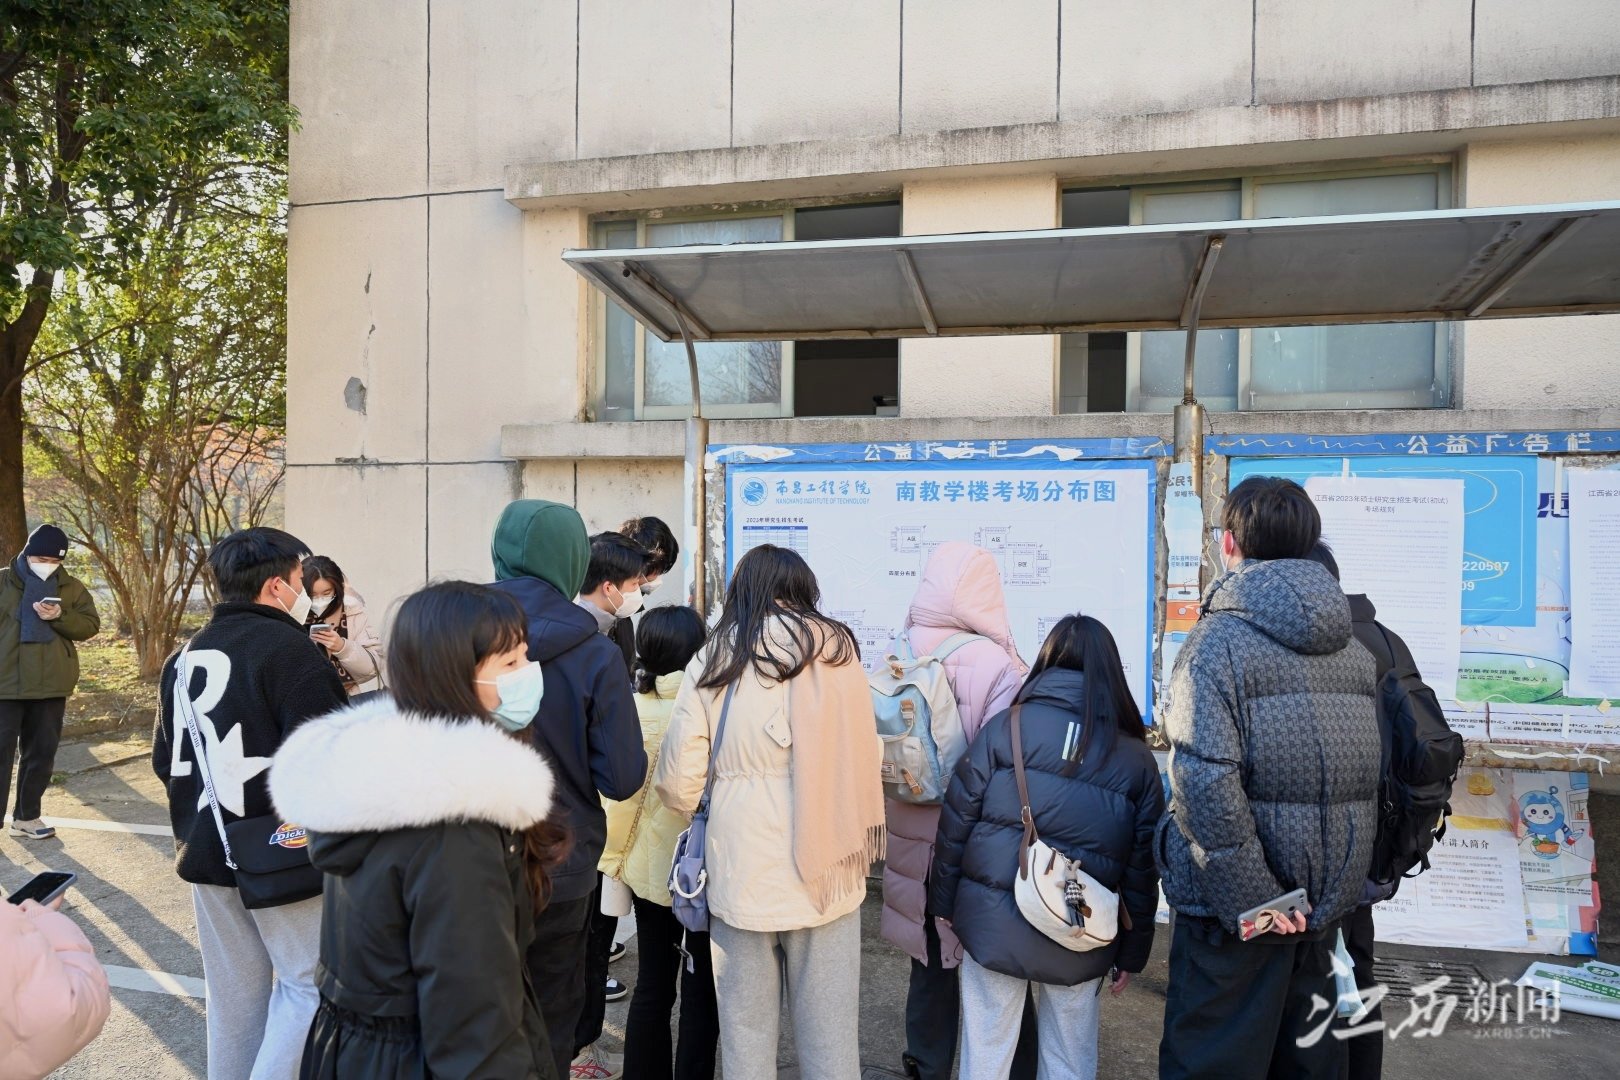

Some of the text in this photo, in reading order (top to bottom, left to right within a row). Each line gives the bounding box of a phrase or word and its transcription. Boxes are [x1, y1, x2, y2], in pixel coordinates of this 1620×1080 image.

[1407, 432, 1591, 455] 公益广告栏
[775, 479, 871, 495] 南昌工程学院
[895, 480, 1116, 502] 南教学楼考场分布图
[1588, 489, 1620, 497] 江西省2
[1365, 506, 1396, 514] 考场规则
[276, 829, 306, 842] Dicki
